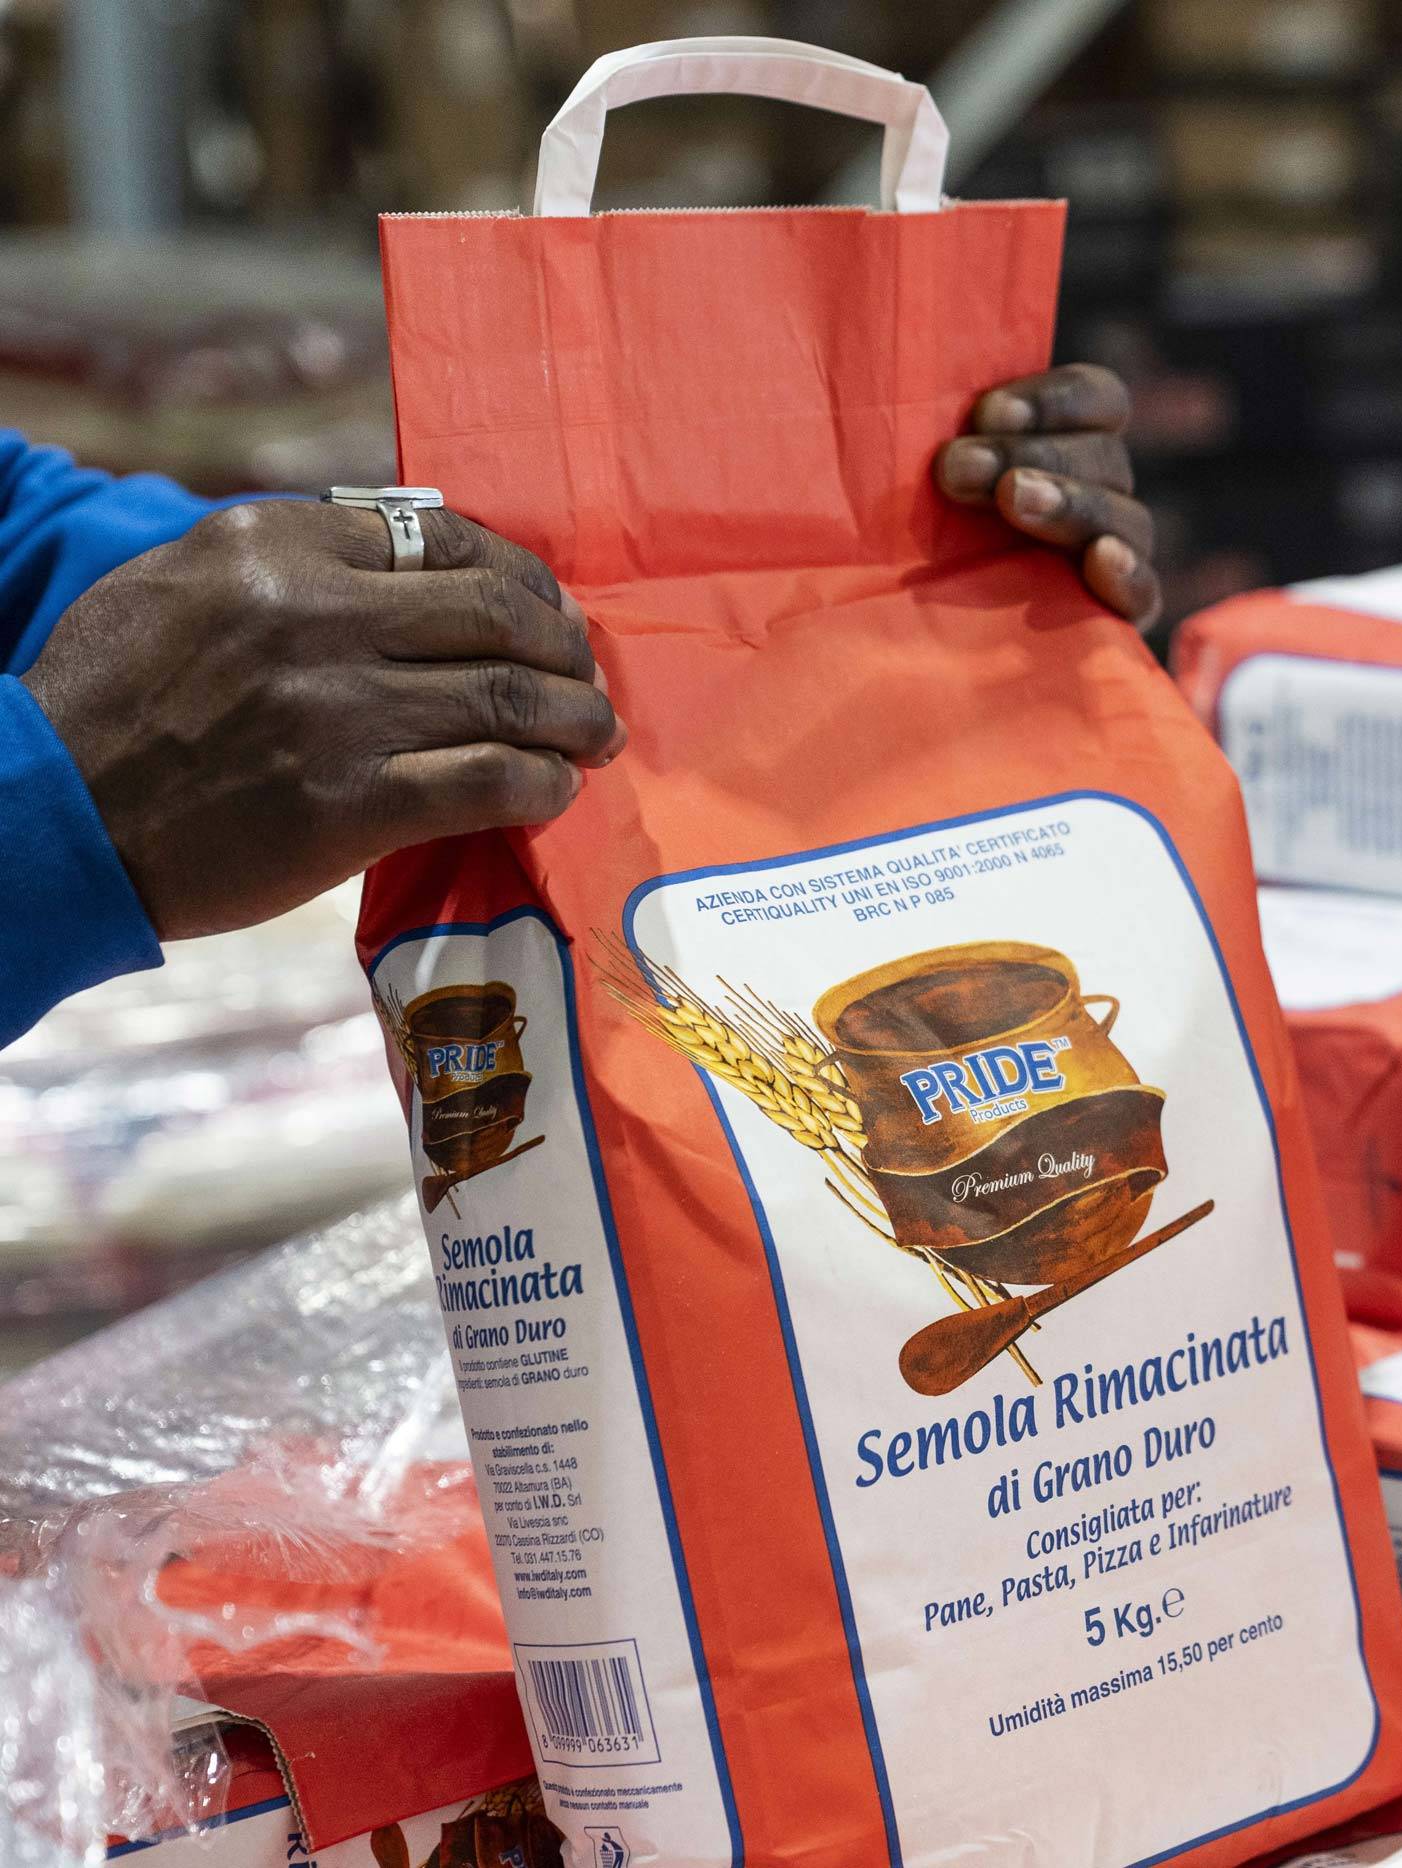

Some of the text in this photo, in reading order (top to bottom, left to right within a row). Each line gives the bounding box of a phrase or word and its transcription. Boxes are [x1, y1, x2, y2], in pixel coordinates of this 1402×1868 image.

[695, 887, 764, 912] AZIENDA
[769, 876, 806, 901] CON
[808, 866, 884, 893] SISTEMA
[966, 821, 1071, 857] CERTIFICATO
[721, 842, 1065, 926] CERTIQUALITY UNI EN ISO 9001:2000 N 4065
[853, 887, 955, 923] BRC N P 085
[427, 1041, 498, 1078] PRIDE
[901, 1041, 1066, 1125] PRIDE
[970, 1097, 1028, 1123] Products
[951, 1151, 1096, 1203] Premium Quality
[440, 1225, 536, 1271] Semola
[453, 1317, 567, 1350] di Grano Duro
[520, 1348, 569, 1367] GLUTINE
[521, 1368, 560, 1386] GRANO
[563, 1366, 589, 1380] duro
[855, 1393, 1037, 1488] Semola
[1053, 1315, 1290, 1430] Rimacinata
[501, 1424, 559, 1440] confezionato
[561, 1419, 589, 1434] nello
[492, 1442, 555, 1458] stabilimento di:
[553, 1457, 578, 1471] 1448
[987, 1416, 1217, 1519] di Grano Duro
[533, 1494, 565, 1510] I.W.D.
[567, 1493, 582, 1507] Srl
[551, 1476, 572, 1491] (BA)
[541, 1531, 576, 1546] Rizzardi
[579, 1527, 604, 1545] (CO)
[1026, 1479, 1203, 1561] Consigliata per:
[924, 1483, 1294, 1632] Pane, Pasta, Pizza e Infarinature
[1084, 1607, 1105, 1648] 5
[988, 1613, 1284, 1738] Umidità massima 15,50 per cento
[541, 1734, 548, 1749] 8
[588, 1736, 639, 1752] 063631
